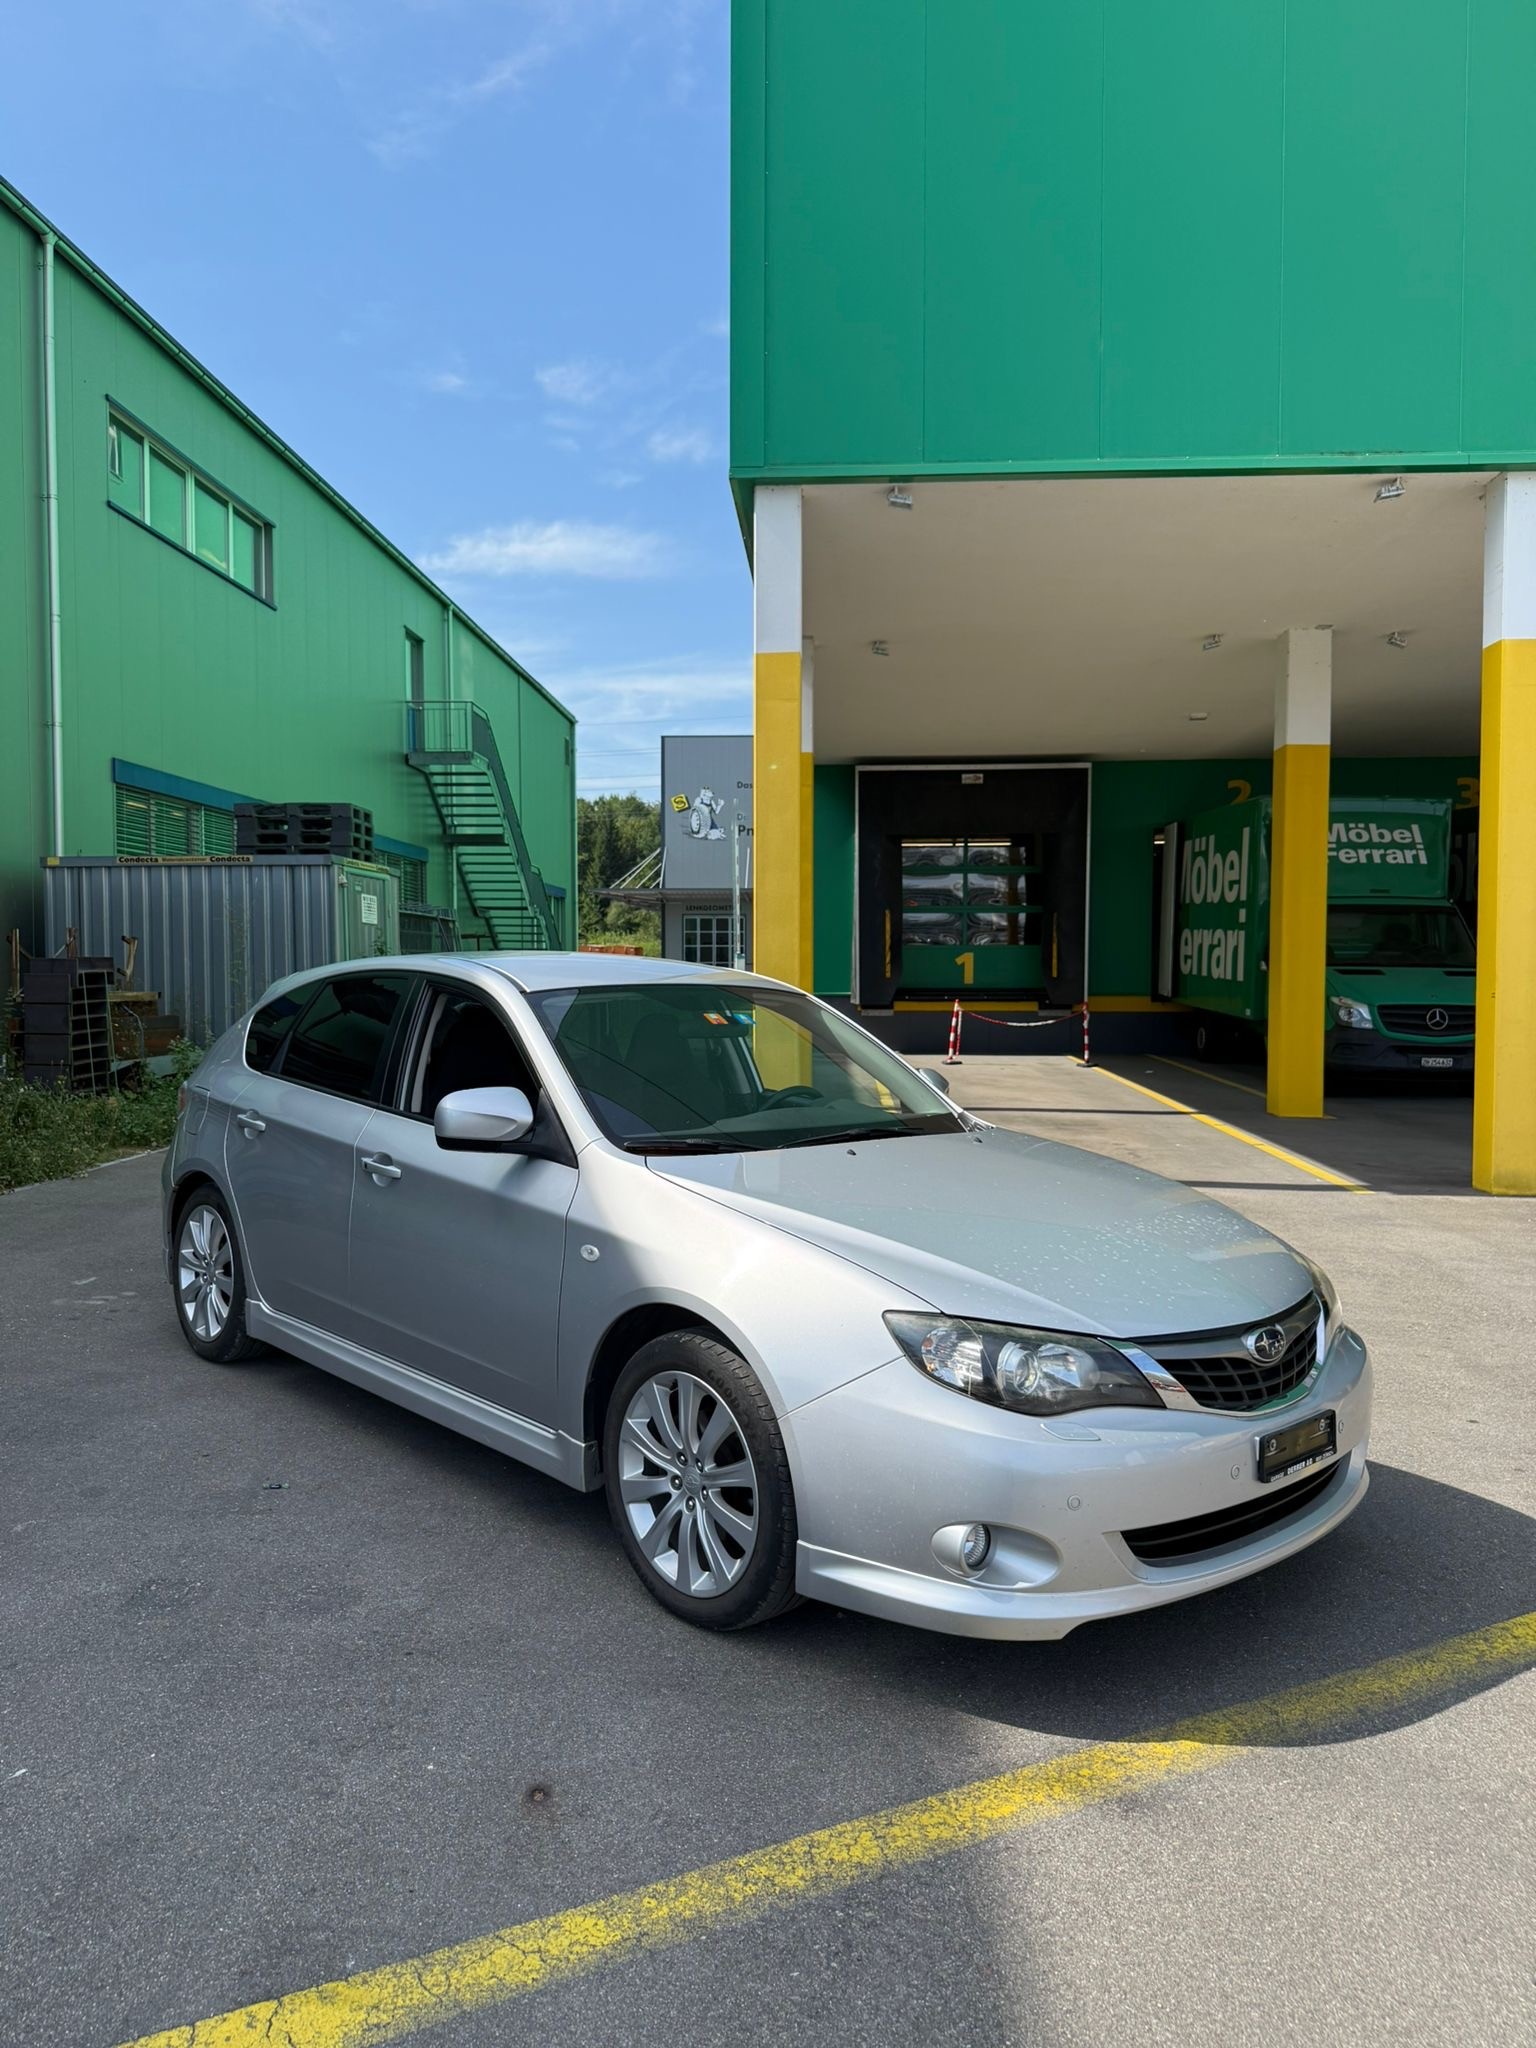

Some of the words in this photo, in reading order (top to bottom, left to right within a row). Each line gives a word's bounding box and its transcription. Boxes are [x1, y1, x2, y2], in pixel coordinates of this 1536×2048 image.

[1227, 779, 1252, 804] 2
[1328, 822, 1423, 844] Möbel
[209, 855, 251, 863] Condecta
[1179, 908, 1247, 982] errari
[954, 951, 975, 985] 1
